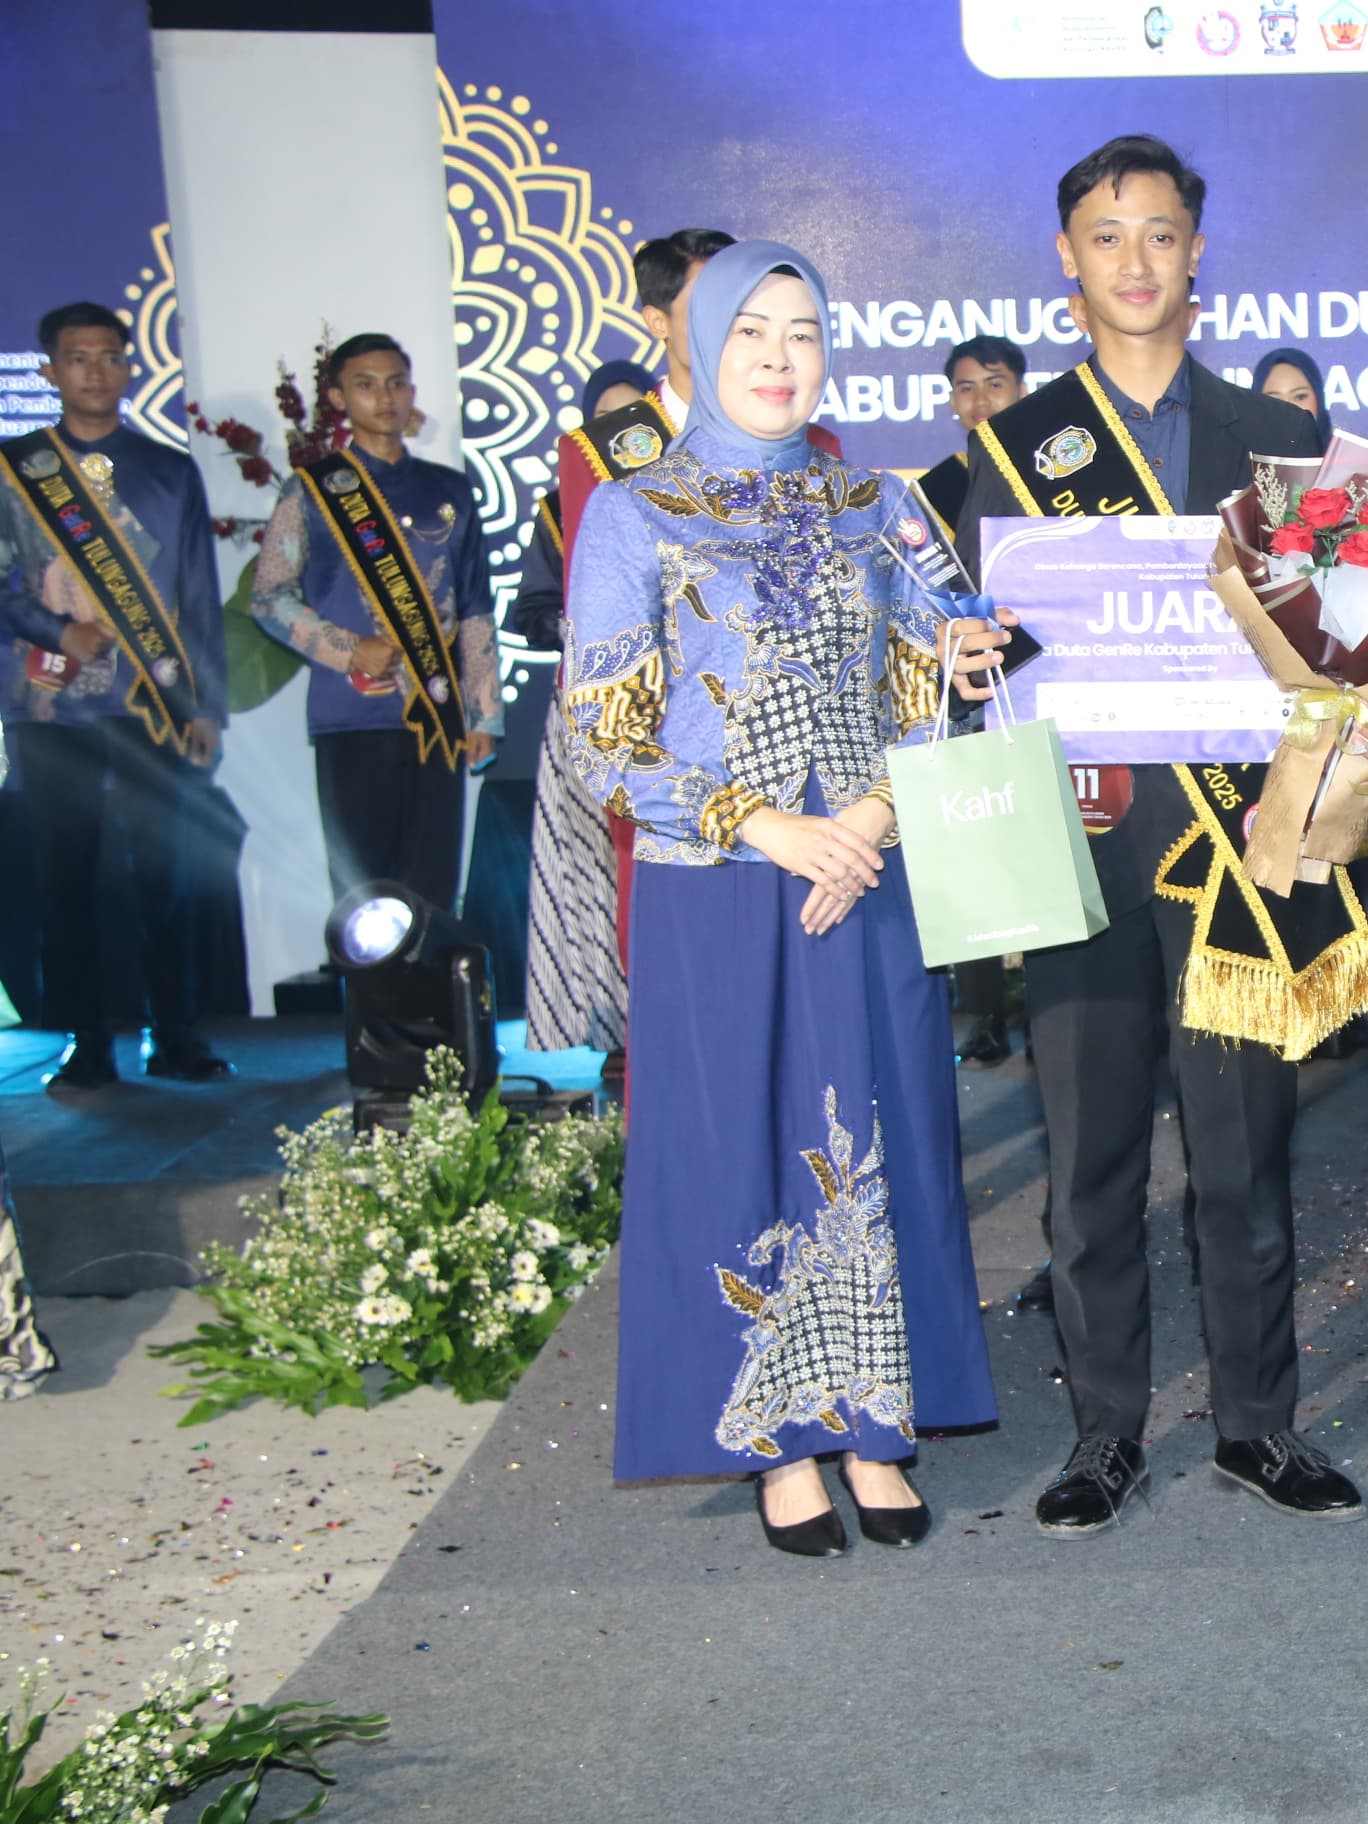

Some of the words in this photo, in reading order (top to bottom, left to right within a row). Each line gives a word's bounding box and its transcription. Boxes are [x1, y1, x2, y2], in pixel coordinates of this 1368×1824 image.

[41, 653, 67, 673] 15
[1054, 643, 1090, 656] Duta
[1093, 643, 1142, 656] GenRe
[1144, 641, 1228, 659] Kabupaten
[1074, 768, 1099, 799] 11
[1202, 763, 1243, 810] 2025
[940, 780, 1016, 825] Kahf
